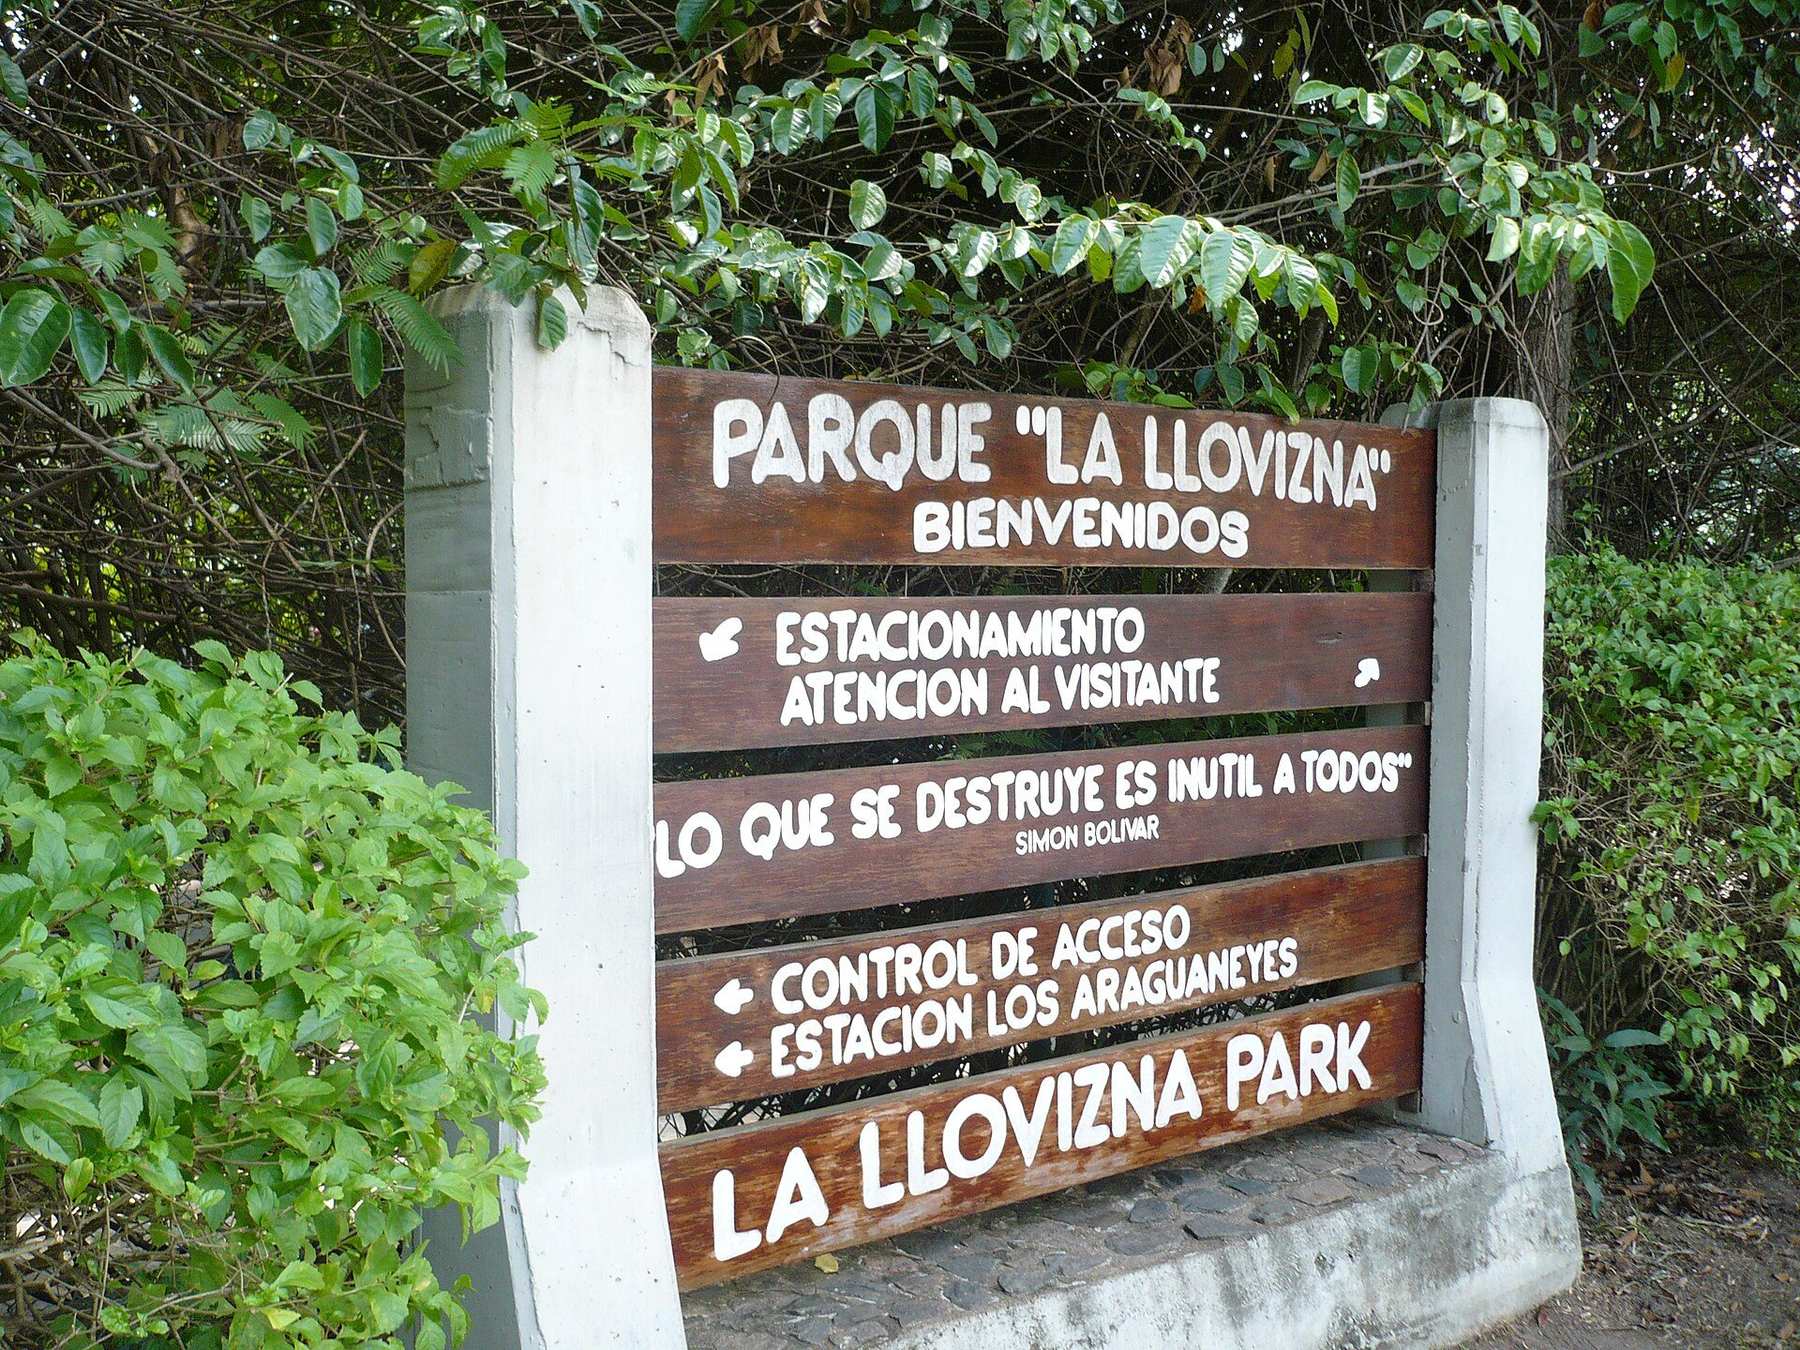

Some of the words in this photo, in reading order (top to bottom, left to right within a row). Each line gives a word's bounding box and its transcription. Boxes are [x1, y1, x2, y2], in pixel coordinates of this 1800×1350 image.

[713, 393, 991, 491] PARQUE
[914, 497, 1249, 558] BIENVENIDOS
[776, 607, 1145, 666] ESTACIONAMIENTO
[780, 668, 988, 726] ATENCION
[1001, 664, 1050, 714] AL
[1054, 657, 1220, 710] VISITANTE
[652, 811, 723, 878] LO
[739, 793, 835, 861] QUE
[850, 784, 901, 839] SE
[916, 764, 1104, 833] DESTRUYE
[1115, 760, 1157, 809] ES
[1168, 753, 1263, 802] INUTIL
[1273, 753, 1296, 795] A
[1015, 825, 1078, 856] SIMON
[1084, 815, 1160, 847] BOLIVAR
[770, 993, 972, 1078] ESTACION
[987, 980, 1059, 1037] LOS
[1071, 937, 1298, 1020] ARAGUANEYES
[771, 938, 978, 1014] CONTROL
[992, 927, 1038, 980] DE
[1052, 904, 1190, 970] ACCESO
[712, 1147, 829, 1261] LA
[858, 1049, 1203, 1209] LLOVIZNA
[1226, 1021, 1372, 1112] PARK
